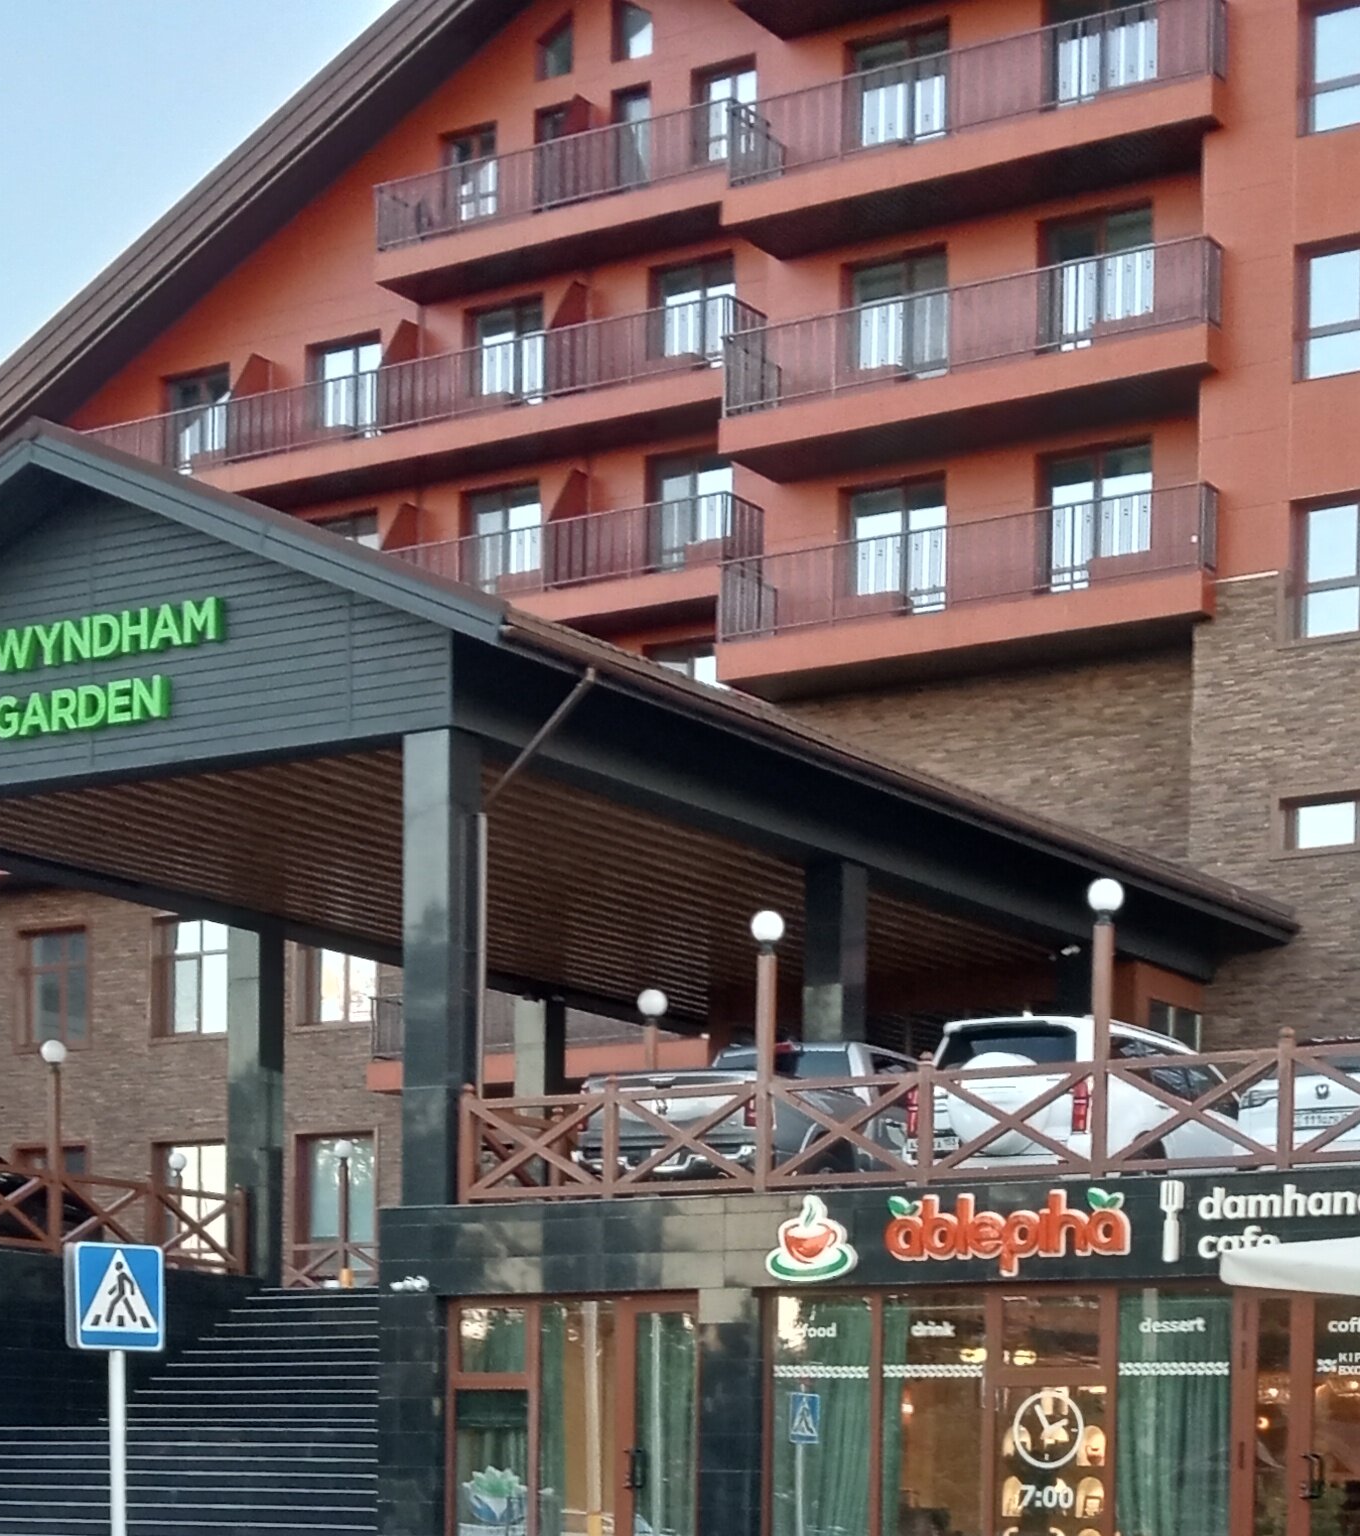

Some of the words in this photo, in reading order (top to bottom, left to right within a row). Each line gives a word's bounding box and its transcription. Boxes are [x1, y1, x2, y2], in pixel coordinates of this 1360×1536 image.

[910, 1319, 956, 1338] drink
[1138, 1316, 1207, 1333] dessert
[1019, 1484, 1074, 1509] 7:00
